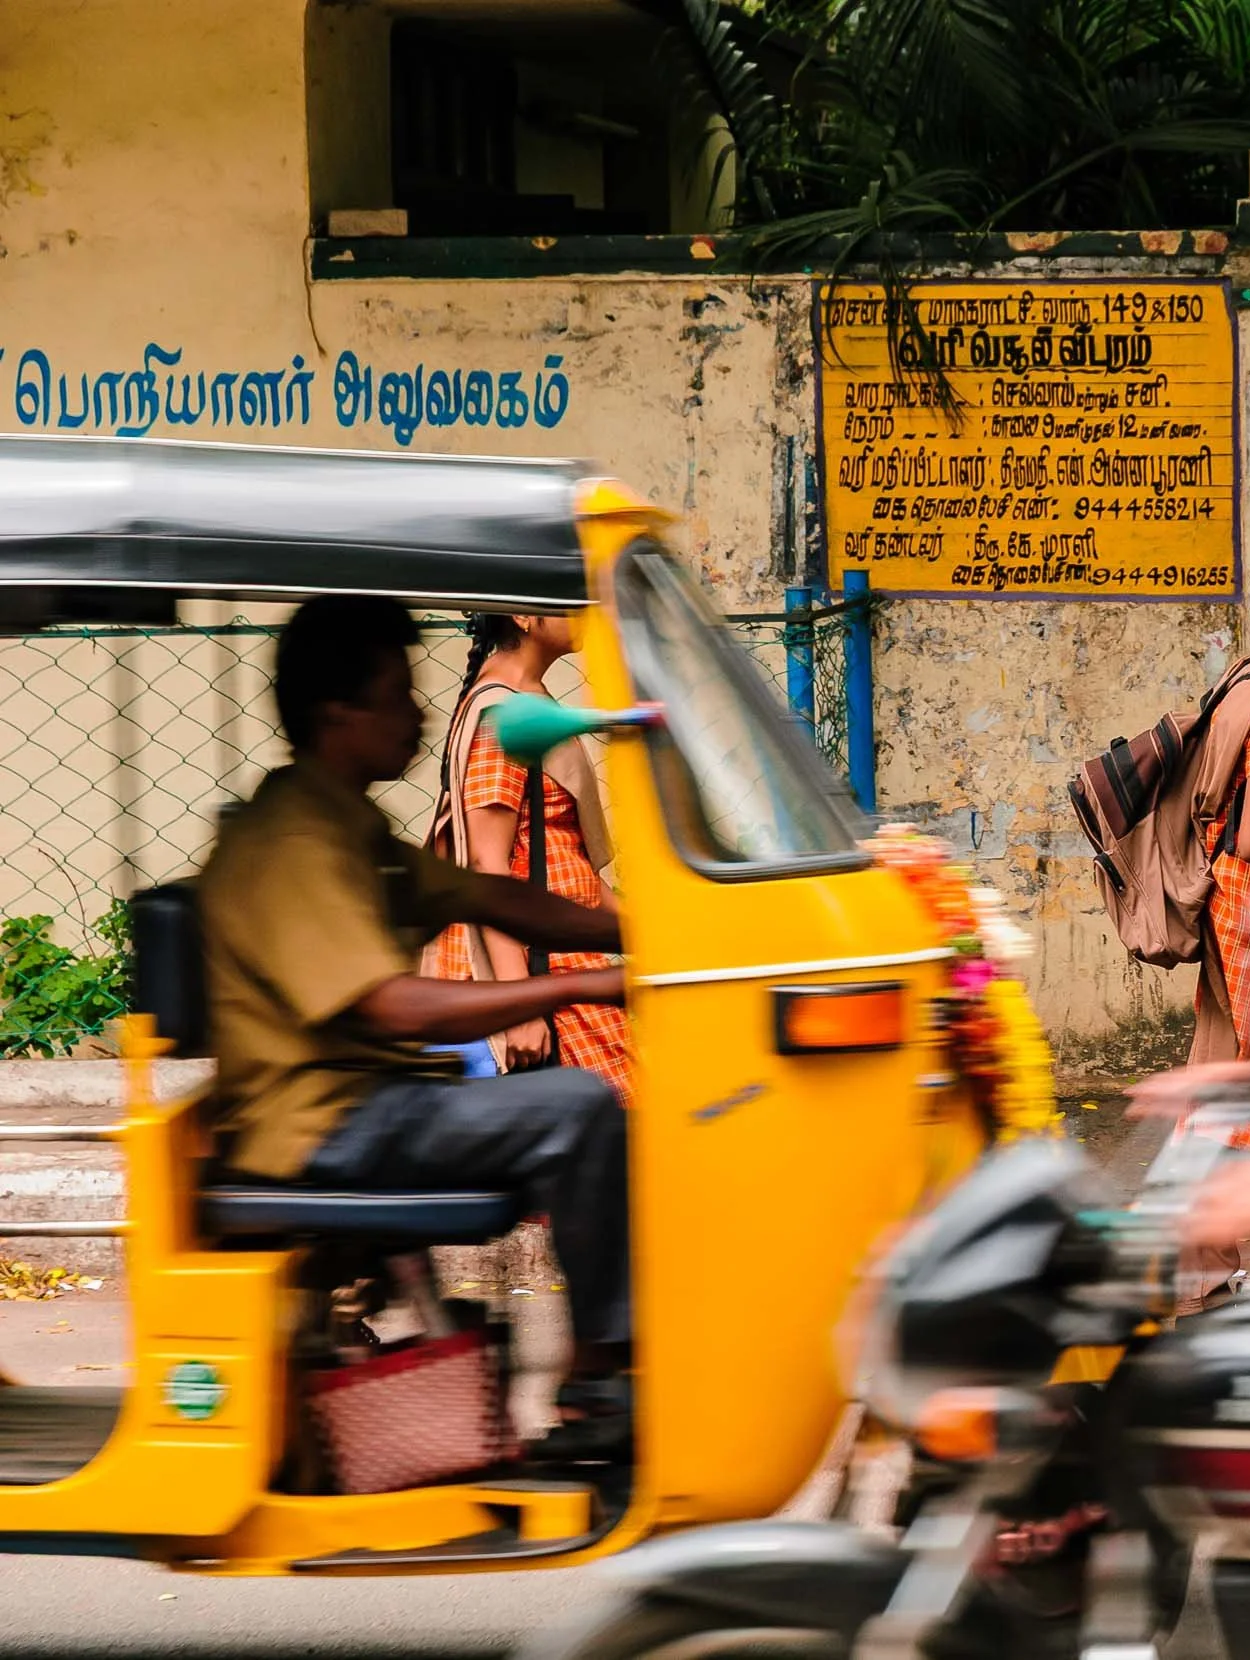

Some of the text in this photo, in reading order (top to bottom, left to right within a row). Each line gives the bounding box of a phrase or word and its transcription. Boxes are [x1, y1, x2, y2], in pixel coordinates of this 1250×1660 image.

[15, 343, 315, 437] பொறியாளர்
[1073, 497, 1215, 521] 9444558214
[1092, 566, 1229, 587] 9444916255
